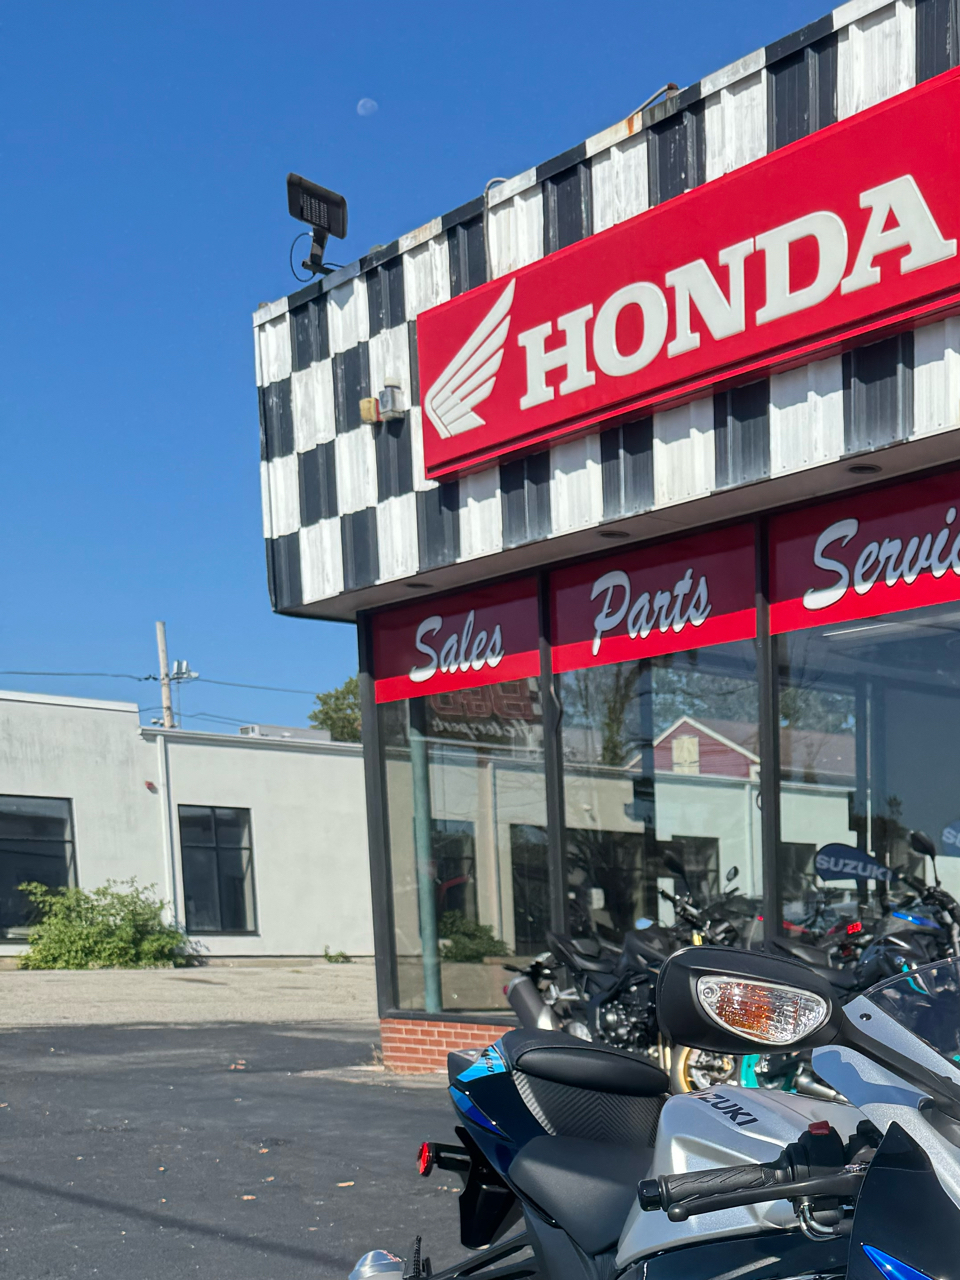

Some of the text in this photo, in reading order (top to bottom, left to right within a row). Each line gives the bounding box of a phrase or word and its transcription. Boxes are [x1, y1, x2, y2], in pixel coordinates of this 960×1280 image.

[519, 174, 957, 410] HONDA
[409, 610, 505, 683] Sales
[590, 568, 712, 656] Parts
[815, 854, 893, 881] SUZUKI
